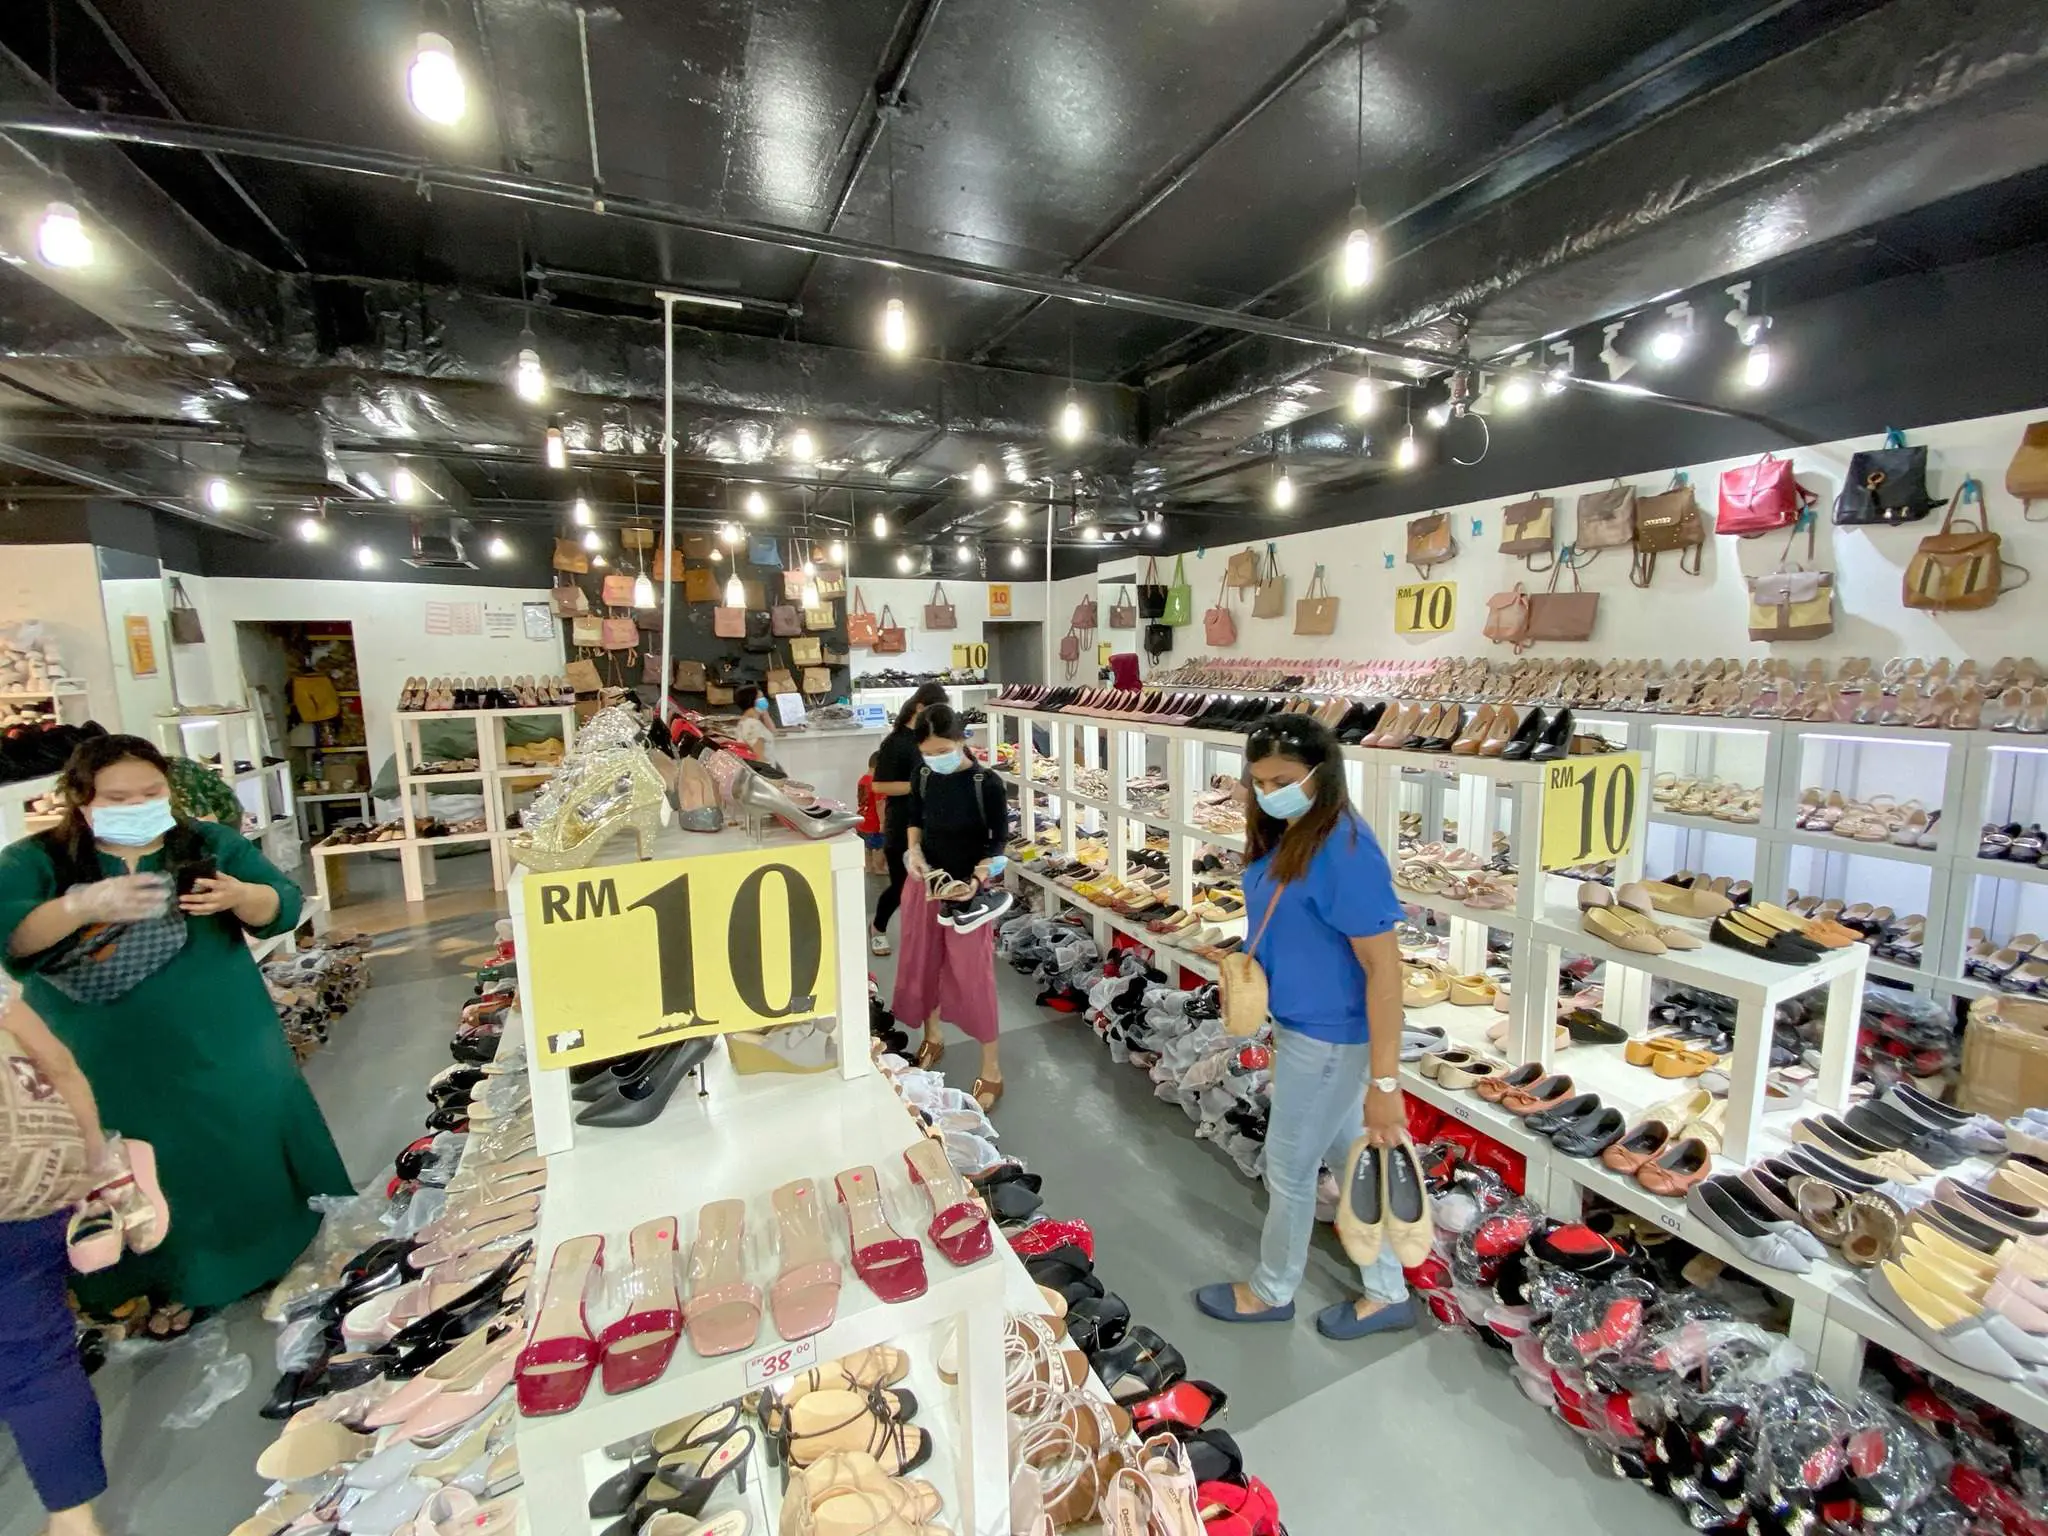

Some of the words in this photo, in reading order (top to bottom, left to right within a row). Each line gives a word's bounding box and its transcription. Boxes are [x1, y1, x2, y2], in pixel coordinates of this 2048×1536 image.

[993, 591, 1008, 604] 10
[1398, 588, 1412, 599] RM
[1408, 586, 1452, 630] 10
[964, 645, 987, 668] 10
[1551, 766, 1574, 789] RM
[1572, 763, 1635, 860] 10
[541, 878, 621, 924] RM
[626, 863, 822, 1039] 10
[762, 1350, 793, 1376] 38
[796, 1343, 810, 1354] 00
